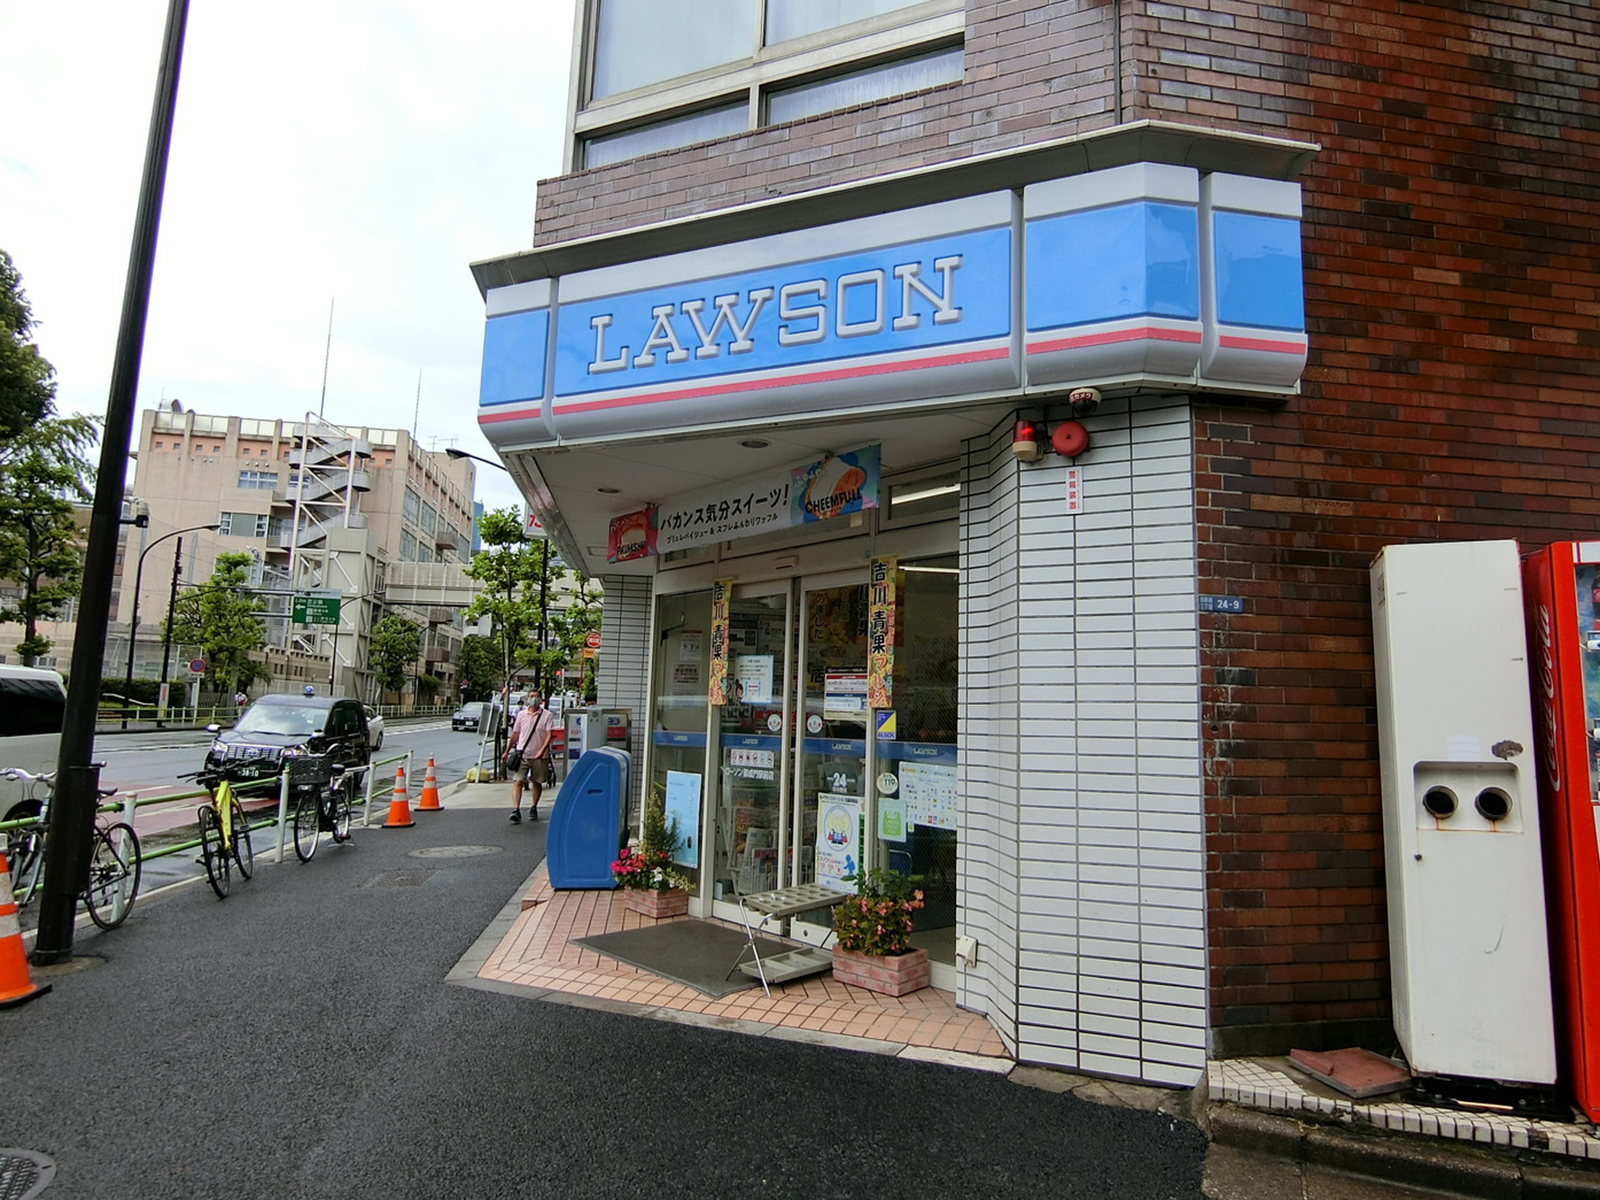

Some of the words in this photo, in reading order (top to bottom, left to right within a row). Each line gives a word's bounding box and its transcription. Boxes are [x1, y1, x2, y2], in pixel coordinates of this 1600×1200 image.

[586, 253, 963, 375] LAWSON
[660, 483, 790, 531] バカンス気分スイーツ!
[804, 487, 863, 513] CHEEMFULL
[1216, 599, 1240, 610] 24-9
[832, 742, 852, 751] LAWSON
[913, 747, 938, 756] LAWSON
[833, 772, 847, 787] 24
